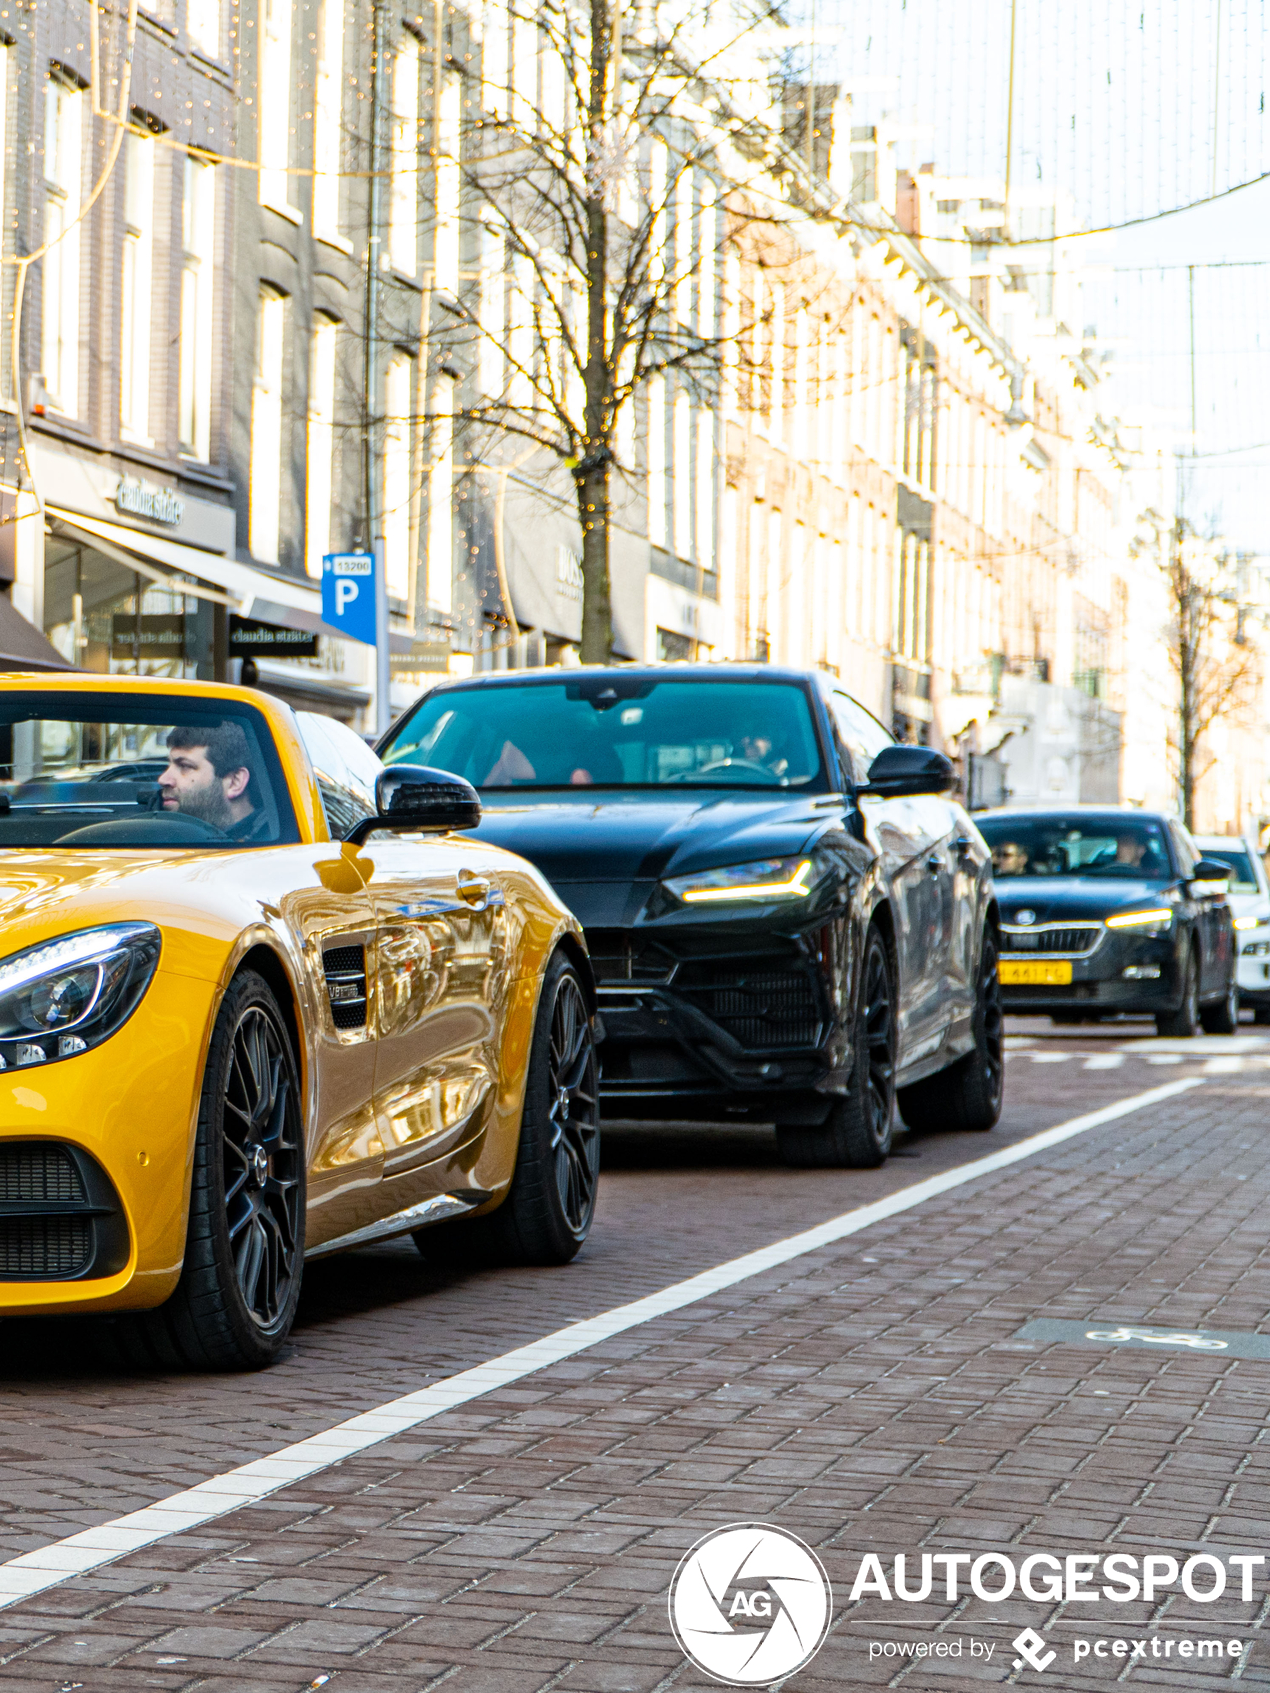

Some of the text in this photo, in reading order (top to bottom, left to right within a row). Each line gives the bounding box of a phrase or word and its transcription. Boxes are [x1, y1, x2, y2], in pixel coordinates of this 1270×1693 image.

[338, 562, 370, 572] 13200
[335, 578, 359, 616] P
[231, 627, 275, 643] claudia
